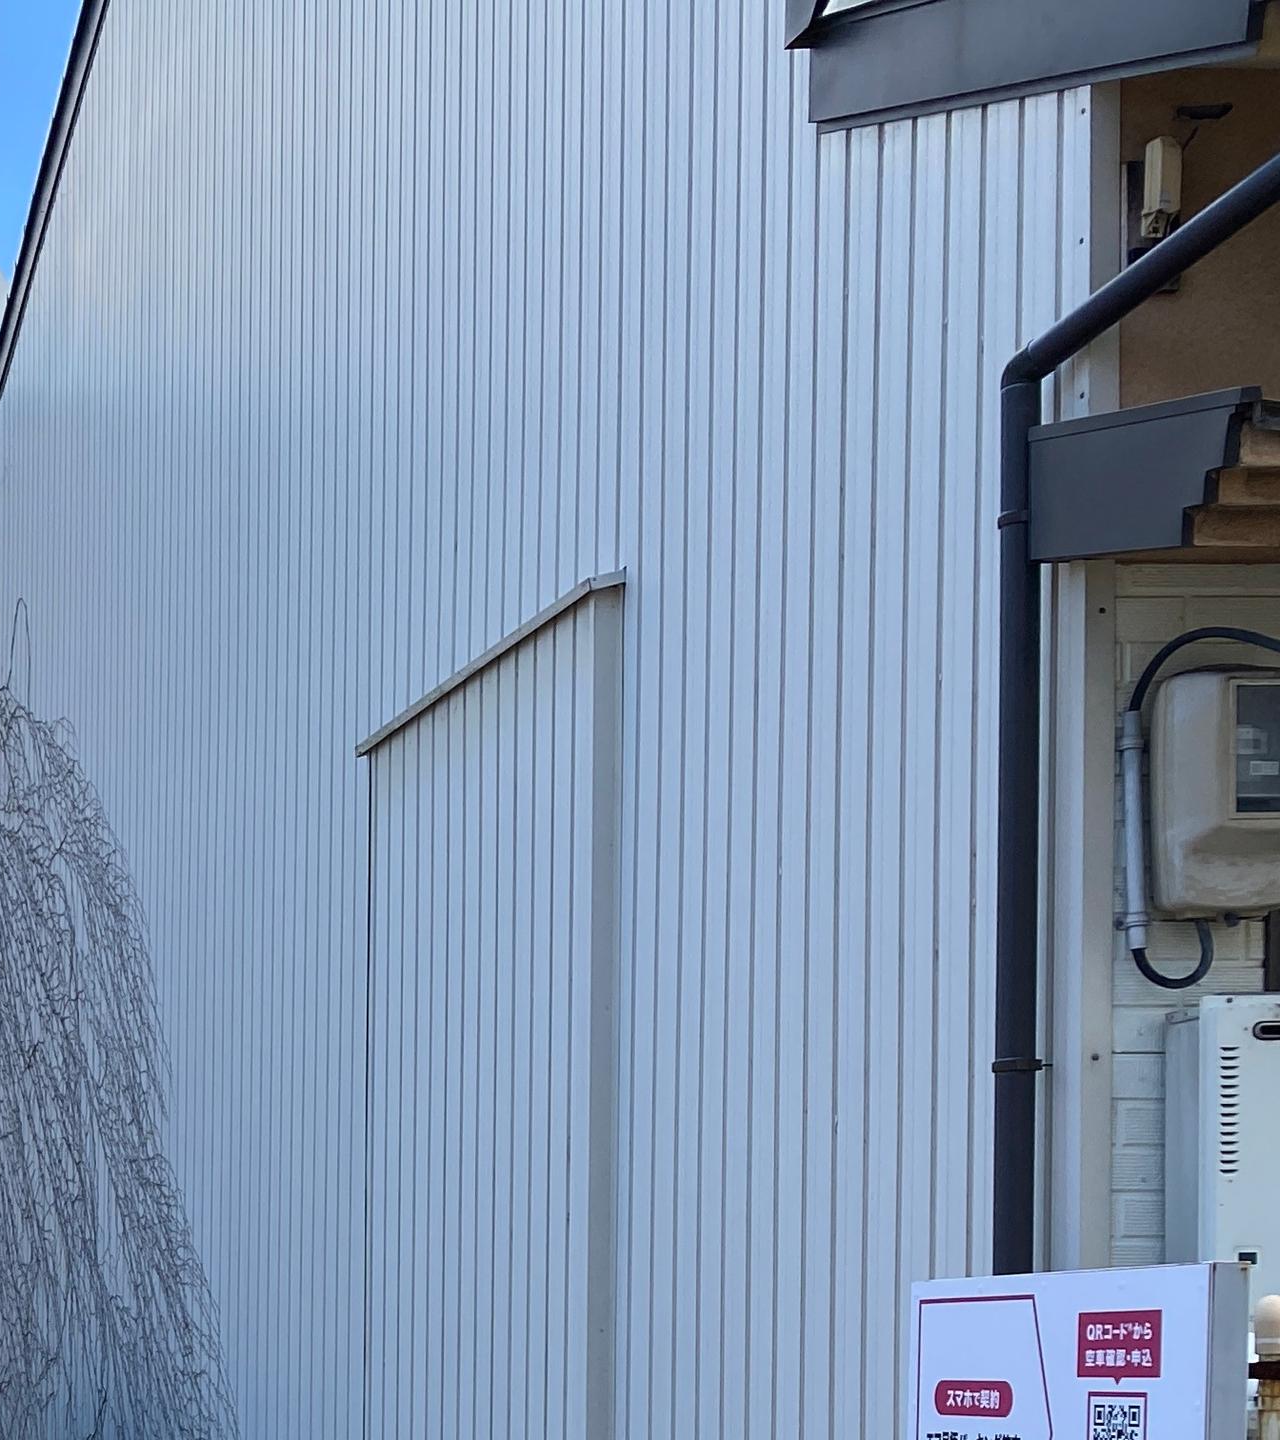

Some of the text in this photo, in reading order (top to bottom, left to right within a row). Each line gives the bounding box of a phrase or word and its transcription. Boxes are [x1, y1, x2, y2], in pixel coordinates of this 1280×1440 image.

[1085, 1348, 1153, 1367] 空車確認・申込
[946, 1389, 1000, 1410] スマホで契約
